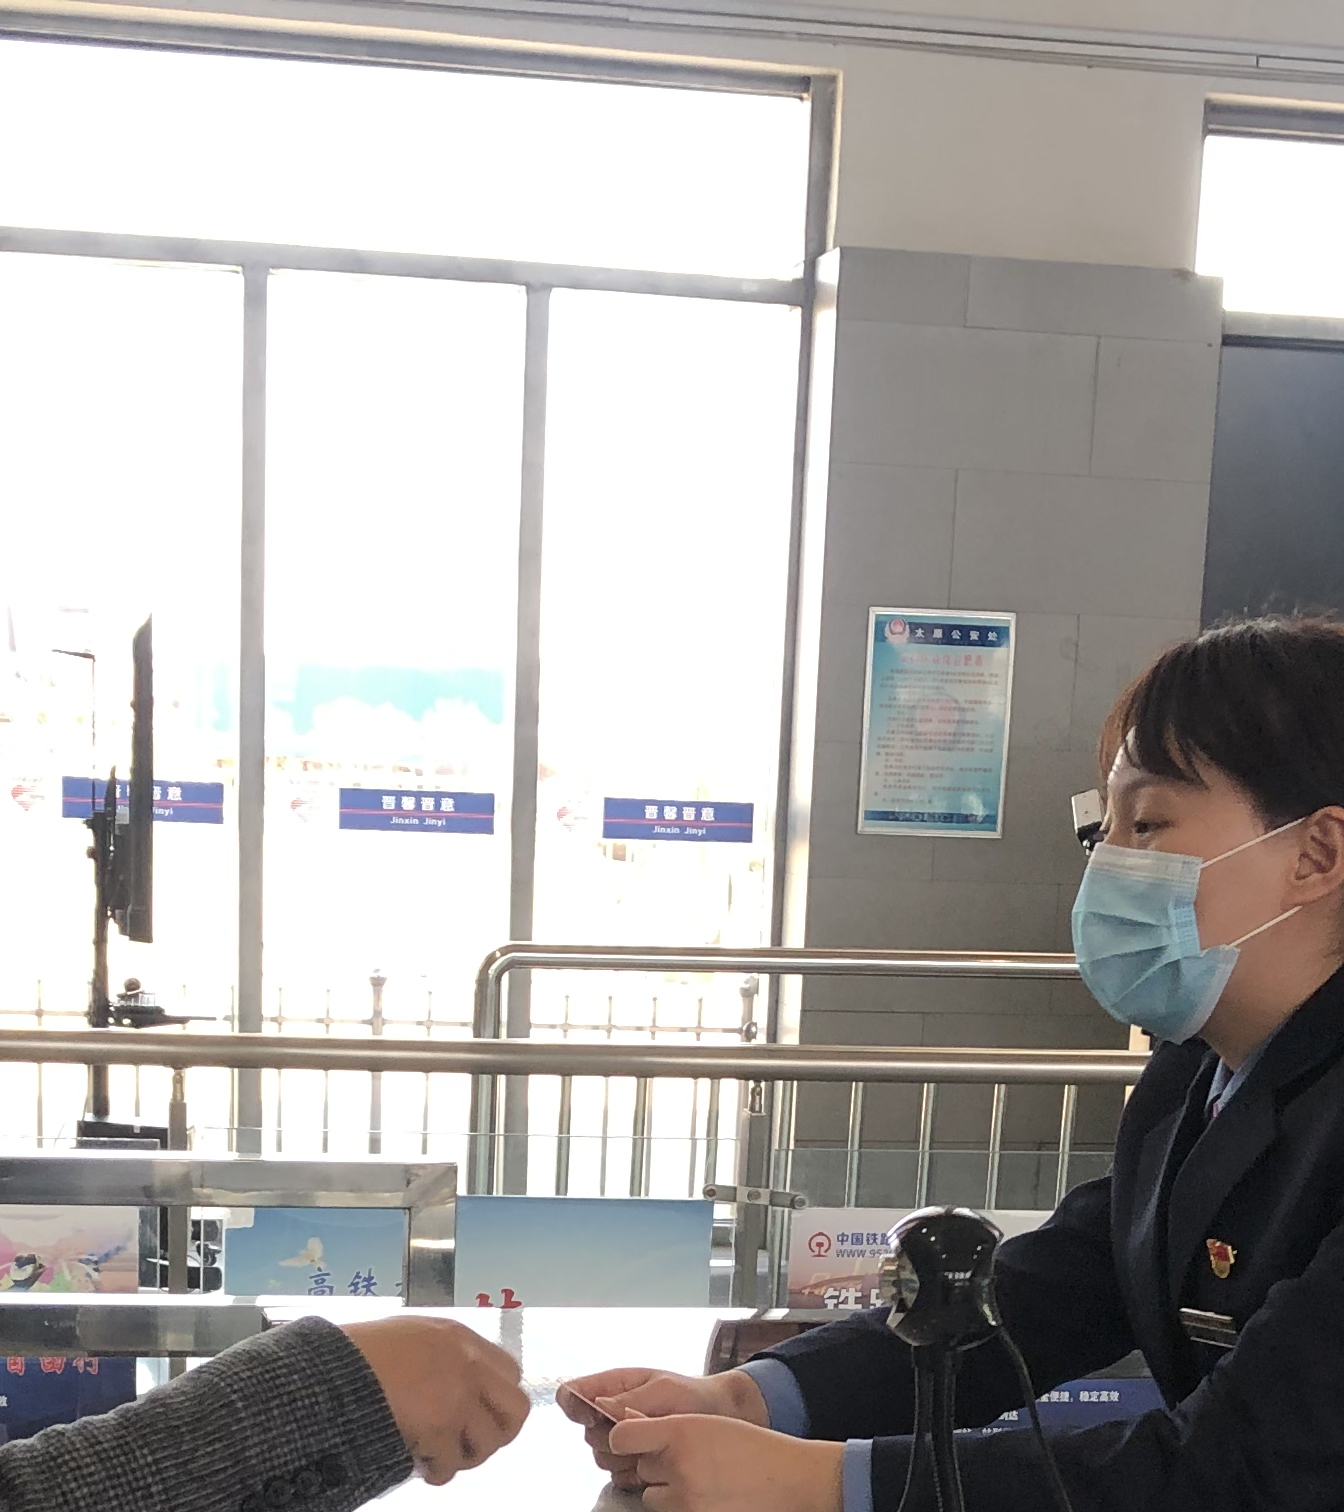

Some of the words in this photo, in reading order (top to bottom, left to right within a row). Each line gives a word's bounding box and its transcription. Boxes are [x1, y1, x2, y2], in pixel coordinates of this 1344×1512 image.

[914, 627, 998, 641] 太原公安处
[389, 816, 420, 825] Jinxin
[423, 817, 446, 827] Jinyi
[652, 825, 680, 834] Jinxin
[684, 827, 706, 837] Jinyi
